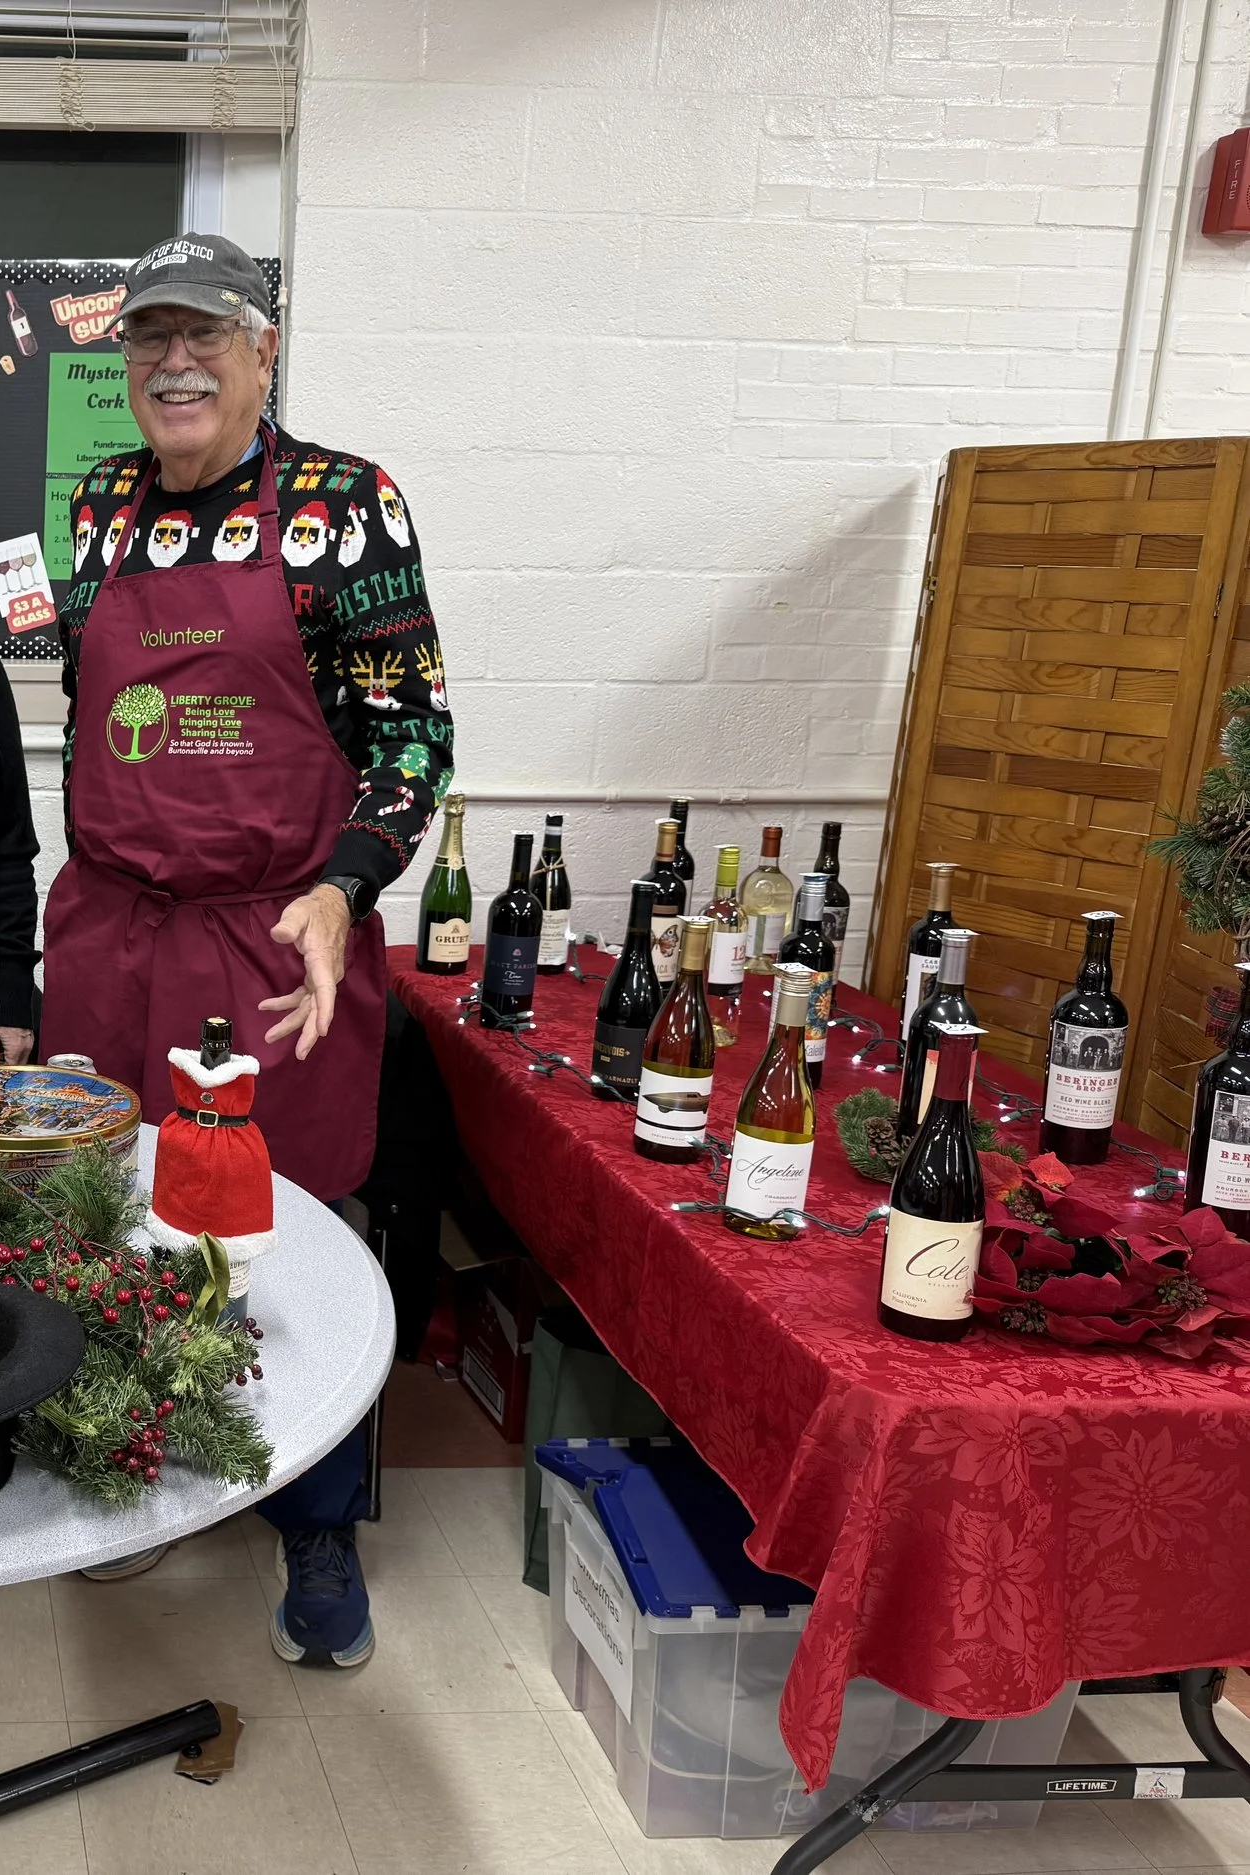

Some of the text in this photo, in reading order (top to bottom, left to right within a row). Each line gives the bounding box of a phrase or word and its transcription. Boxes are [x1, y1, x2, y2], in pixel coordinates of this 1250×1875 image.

[1229, 159, 1241, 200] FIRE
[135, 240, 214, 276] GULF OF MEXICO
[67, 363, 128, 384] Myster
[87, 393, 125, 409] Cork
[93, 441, 138, 449] Fundraiser
[13, 597, 42, 613] $3 A
[12, 608, 51, 627] GLASS
[140, 627, 225, 647] Volunteer
[170, 696, 256, 705] LIBERTY GROVE:
[185, 707, 235, 718] Being Love
[179, 718, 241, 728] Bringing Love
[181, 728, 239, 738] Sharing Love
[220, 740, 245, 748] known
[168, 747, 208, 755] Burtonsville
[226, 747, 253, 756] beyond
[435, 935, 469, 944] GRUET
[1055, 1073, 1118, 1087] BERINGER
[1060, 1095, 1072, 1103] RED
[735, 1155, 805, 1190] Angeline
[1227, 1175, 1242, 1183] RED
[905, 1238, 969, 1280] Cole
[892, 1289, 927, 1303] CALIFORNIA
[572, 1575, 624, 1666] Decorations
[1055, 1781, 1108, 1791] LIFETIME
